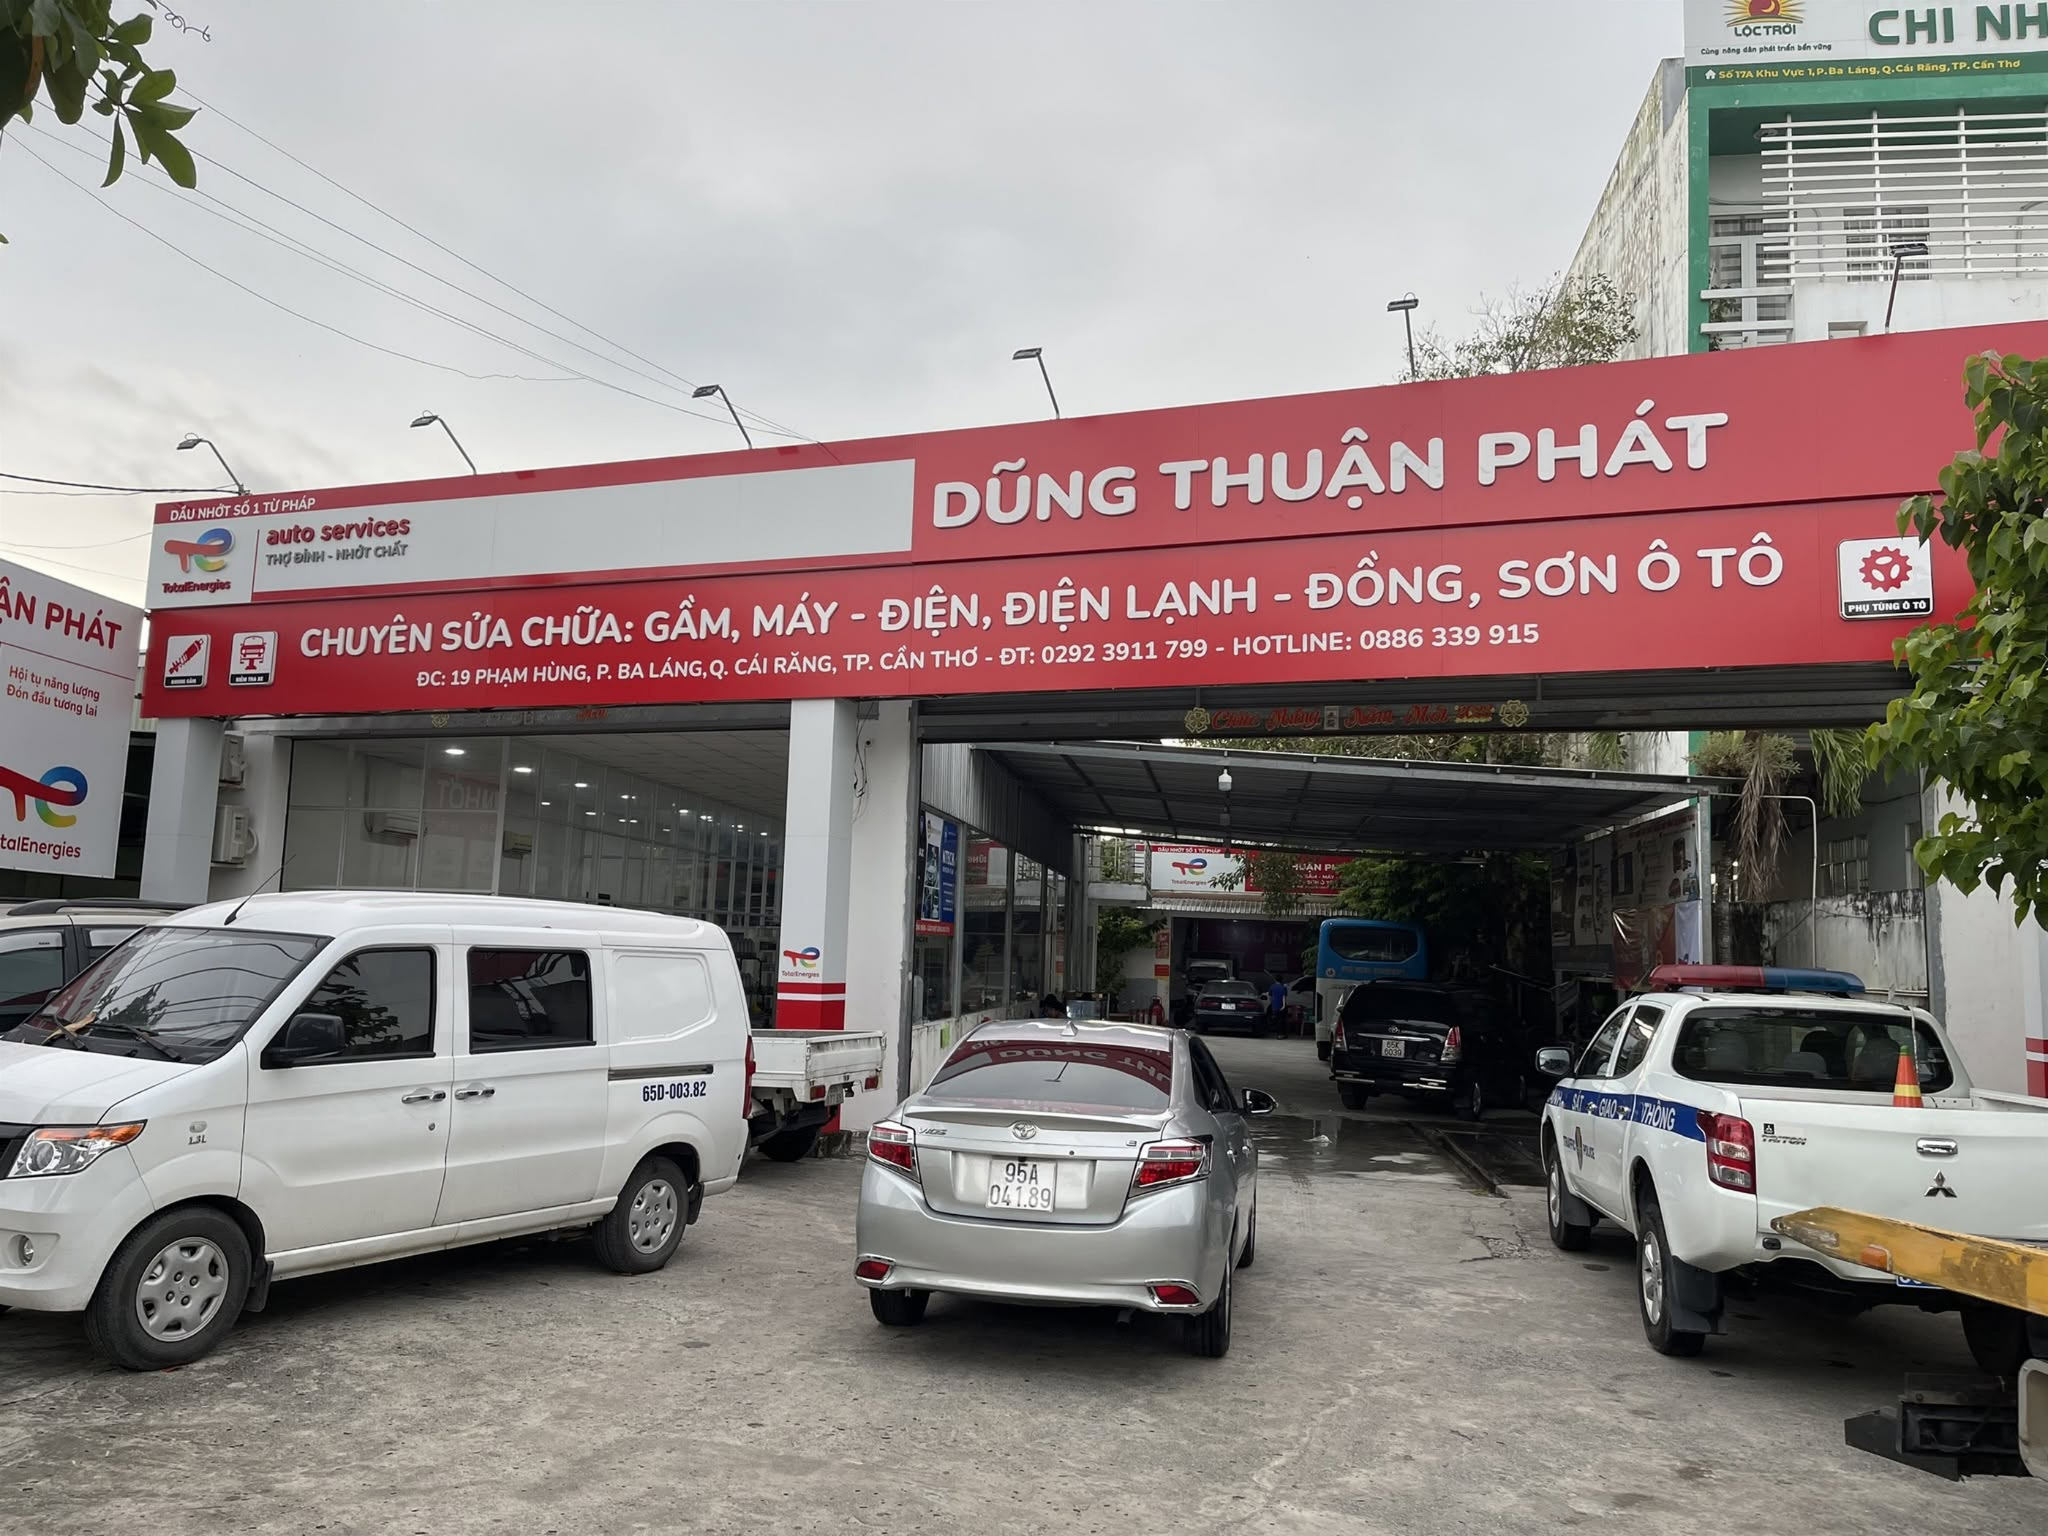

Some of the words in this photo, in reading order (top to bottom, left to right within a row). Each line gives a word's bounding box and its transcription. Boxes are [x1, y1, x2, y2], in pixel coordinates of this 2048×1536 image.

[1868, 7, 1954, 45] CHI
[1976, 2, 2048, 42] NH
[1719, 69, 1733, 79] Số
[1736, 70, 1754, 79] 17A
[1756, 69, 1779, 78] Khu
[1783, 68, 1804, 79] Vực
[1848, 65, 1880, 75] Láng,
[1952, 61, 1970, 71] TP.
[1998, 59, 2021, 68] Thơ
[933, 456, 1137, 529] DŨNG
[1158, 427, 1446, 511] THUẬN
[1477, 398, 1729, 486] PHÁT
[170, 504, 195, 521] DẦU
[198, 500, 231, 519] NHỚT
[233, 498, 250, 517] SỐ
[253, 501, 260, 515] 1
[263, 497, 281, 513] TỪ
[283, 496, 316, 512] PHÁP
[266, 524, 316, 546] auto
[320, 516, 411, 541] services
[266, 551, 290, 568] THỢ
[336, 543, 371, 561] NHỚT
[374, 541, 408, 559] CHẤT
[161, 579, 231, 595] TotalEnergies
[300, 613, 434, 658] CHUYÊN
[441, 611, 513, 652] SỬA
[521, 604, 634, 648] CHỮA:
[643, 593, 741, 644] GẦM,
[752, 591, 840, 638] MÁY
[878, 584, 993, 637] ĐIỆN,
[1001, 576, 1110, 633] ĐIỆN
[1126, 575, 1257, 625] LẠNH
[1303, 549, 1482, 610] ĐỒNG,
[1498, 550, 1617, 599] SƠN
[1637, 538, 1681, 593] Ô
[1697, 531, 1784, 588] TÔ
[1847, 604, 1870, 613] PHỤ
[1872, 601, 1900, 611] TÙNG
[1902, 600, 1910, 610] Ô
[1912, 600, 1927, 610] TÔ
[45, 601, 122, 650] PHÁT
[416, 669, 446, 687] ĐC:
[450, 667, 471, 686] 19
[475, 666, 528, 688] PHẠM
[533, 660, 591, 685] HÙNG,
[596, 664, 612, 681] P.
[617, 662, 644, 680] BA
[649, 653, 707, 680] LÁNG,
[734, 652, 767, 676] CÁI
[774, 651, 837, 676] RĂNG,
[843, 653, 873, 672] TP.
[879, 646, 925, 670] CẦN
[931, 645, 979, 667] THƠ
[999, 645, 1036, 666] ĐT:
[1041, 643, 1095, 664] 0292
[1102, 641, 1157, 661] 3911
[1165, 638, 1208, 658] 799
[1233, 631, 1352, 656] HOTLINE:
[1359, 627, 1424, 650] 0886
[1431, 625, 1481, 647] 339
[1488, 623, 1540, 645] 915
[9, 665, 28, 684] Hội
[31, 672, 41, 688] tụ
[44, 677, 69, 694] năng
[72, 682, 100, 702] lượng
[6, 684, 29, 700] Đón
[31, 690, 51, 705] đầu
[54, 697, 83, 716] tương
[85, 703, 98, 717] lai
[782, 970, 820, 978] TotalEnergies
[642, 1080, 706, 1102] 65D-003.82
[1598, 1098, 1618, 1118] GIAO
[1641, 1099, 1676, 1131] THÔNG
[919, 1126, 948, 1136] VIOS
[1583, 1143, 1596, 1160] POLICE
[1005, 1162, 1039, 1185] 95A
[989, 1184, 1052, 1209] 041.89
